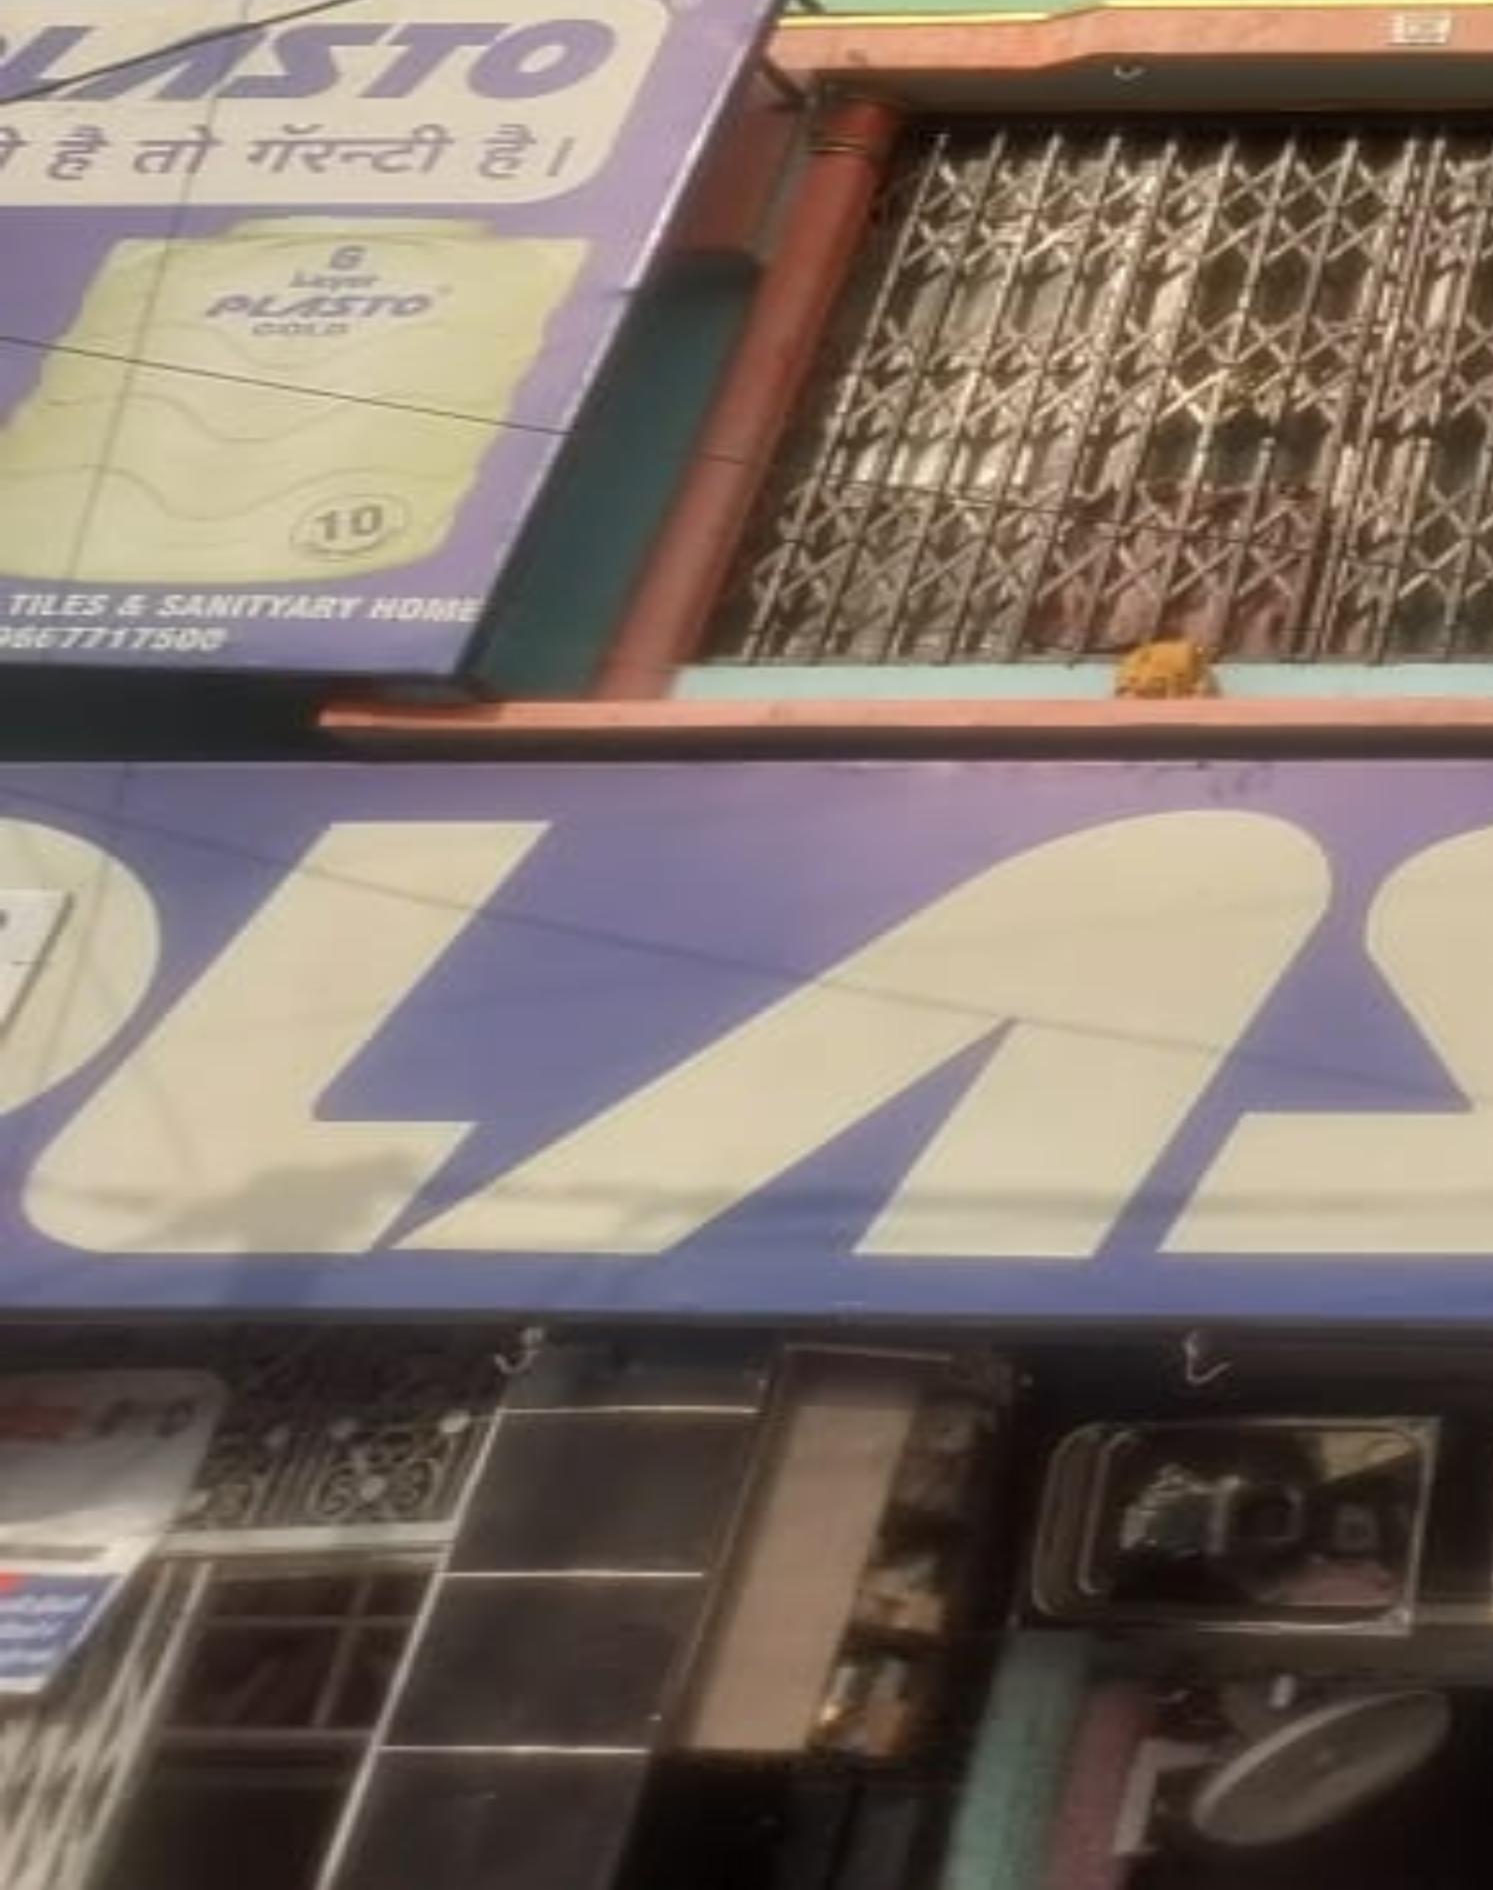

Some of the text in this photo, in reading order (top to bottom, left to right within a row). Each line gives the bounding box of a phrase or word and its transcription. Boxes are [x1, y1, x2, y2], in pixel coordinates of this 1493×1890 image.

[0, 18, 617, 102] LASTO
[47, 123, 110, 180] है
[132, 124, 224, 174] तो
[205, 293, 434, 319] PLASTO
[312, 506, 384, 541] 10
[9, 593, 109, 617] TILES
[370, 597, 484, 624] HOME
